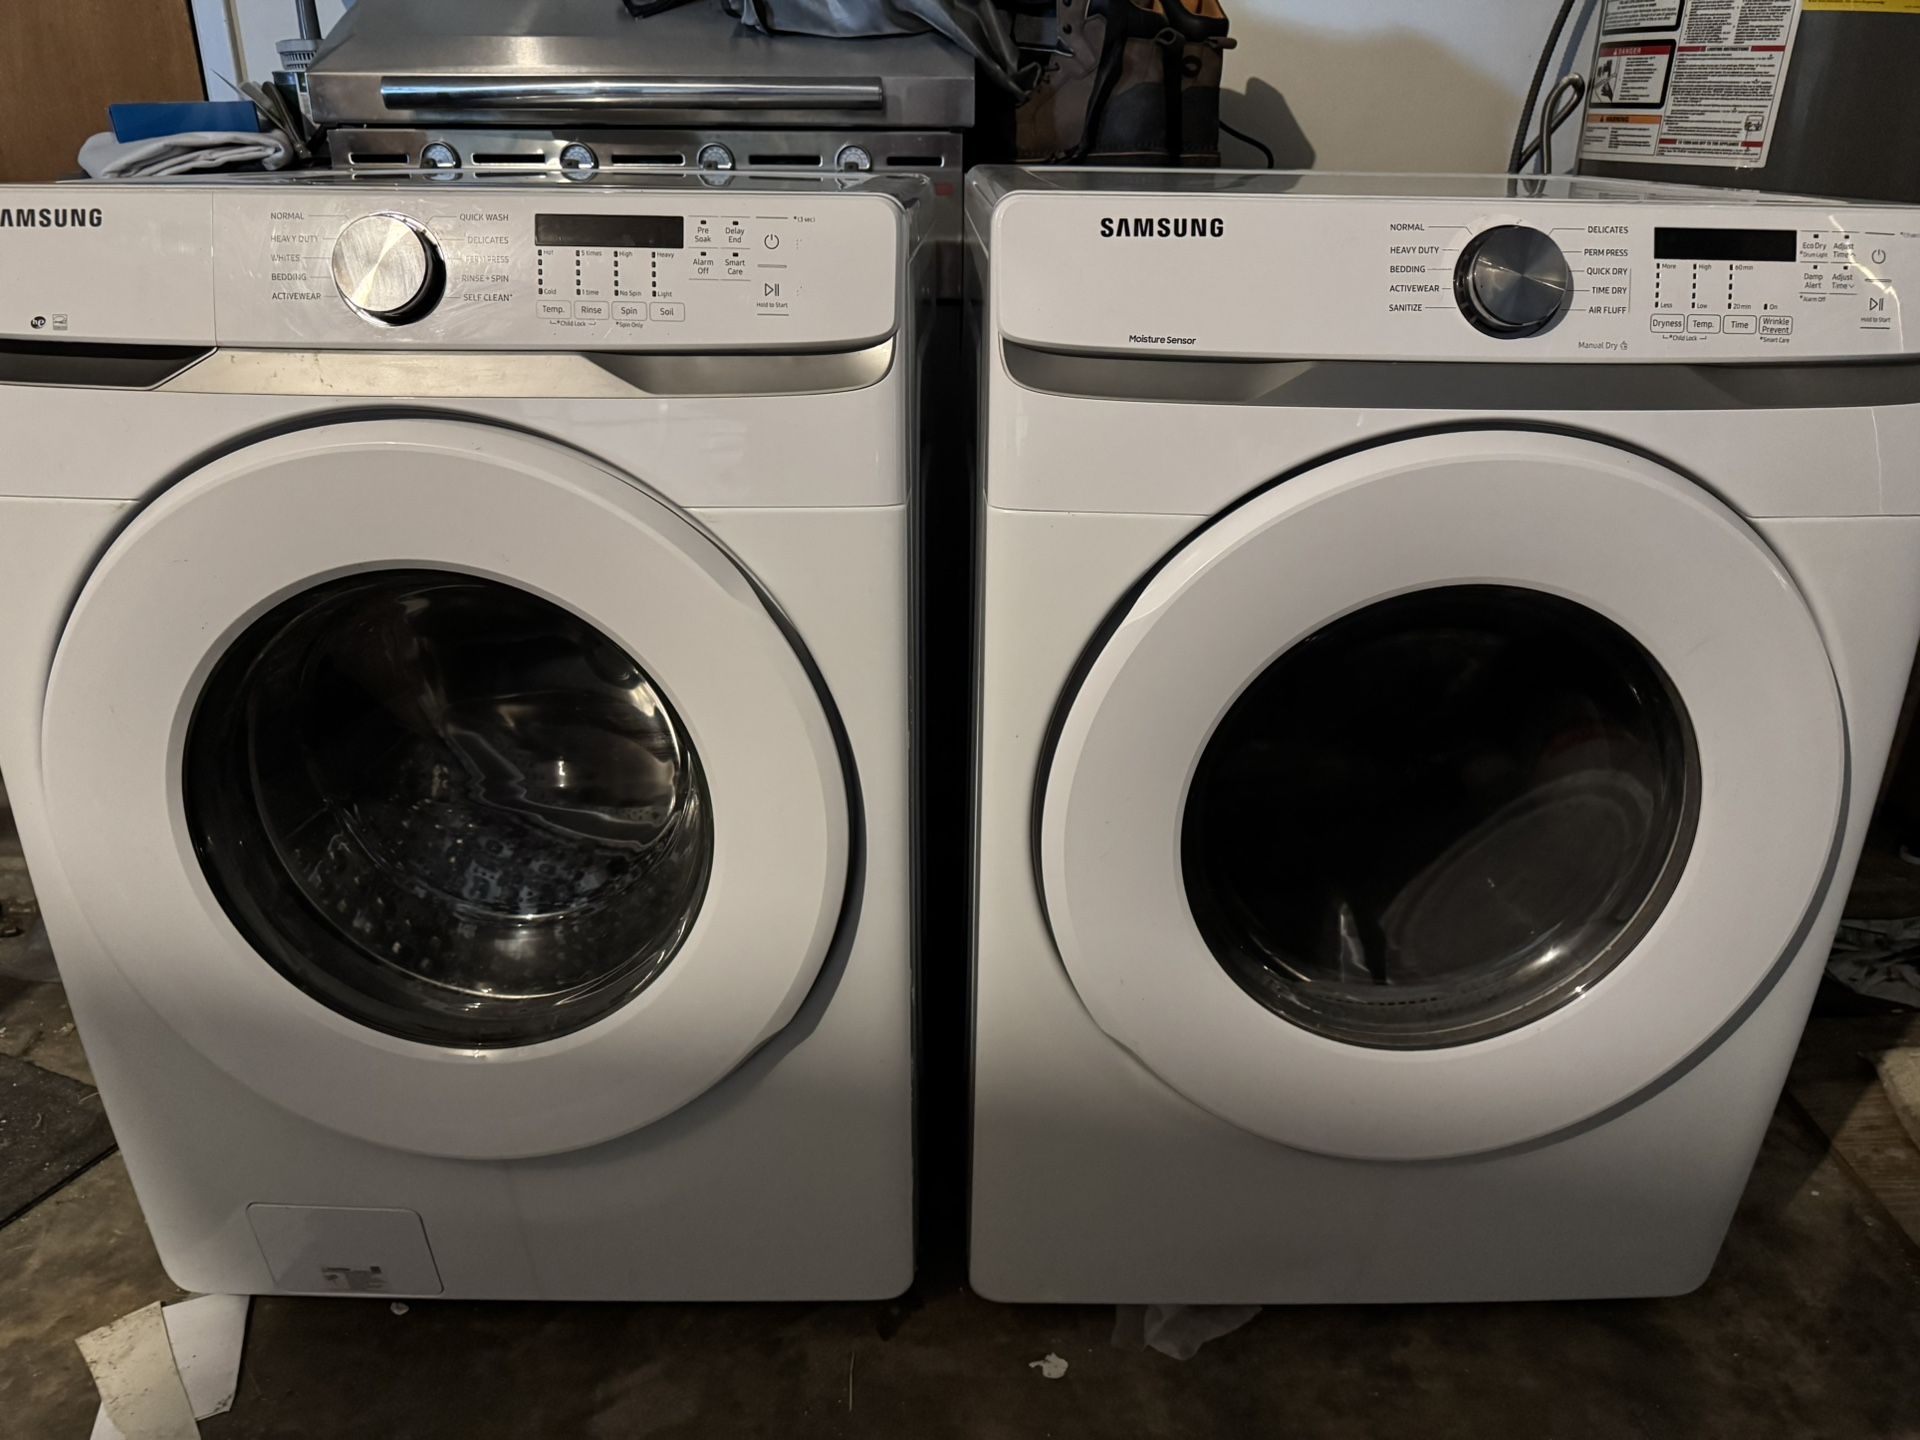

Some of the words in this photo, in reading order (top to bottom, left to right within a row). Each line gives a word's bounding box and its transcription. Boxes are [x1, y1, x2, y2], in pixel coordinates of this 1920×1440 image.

[270, 212, 304, 220] NORMAL
[459, 213, 484, 222] QUICK
[485, 213, 509, 221] WASH
[697, 226, 709, 234] Pre
[1100, 217, 1224, 238] SAMSUNG
[1390, 223, 1425, 231] NORMAL
[1587, 226, 1629, 234] DELICATES
[725, 227, 745, 236] Delay
[270, 235, 296, 243] HEAVY
[299, 235, 318, 243] DUTY
[467, 236, 509, 244] DELICATES
[694, 235, 712, 243] Soak
[728, 236, 742, 244] End
[1390, 246, 1417, 254] HEAVY
[1418, 246, 1440, 254] DUTY
[1833, 242, 1854, 251] Adjust
[1584, 248, 1605, 257] PERM
[1605, 249, 1629, 257] PRESS
[271, 254, 300, 262] WHITES
[693, 258, 714, 266] Alarm
[725, 259, 746, 267] Smart
[697, 267, 709, 275] Off
[1390, 265, 1426, 273] BEDDING
[1586, 267, 1611, 276] QUICK
[1611, 267, 1628, 275] DRY
[1698, 263, 1712, 272] High
[727, 268, 743, 276] Care
[271, 273, 307, 281] BEDDING
[1803, 273, 1823, 281] Damp
[1832, 273, 1853, 282] Adjust
[1389, 284, 1440, 292] ACTIVEWEAR
[1804, 281, 1822, 289] Alert
[1832, 282, 1848, 290] Time
[1592, 286, 1610, 294] TIME
[1611, 286, 1627, 295] DRY
[272, 292, 321, 300] ACTIVEWEAR
[463, 294, 482, 302] SELF
[542, 305, 565, 314] Temp.
[581, 306, 602, 314] Rinse
[621, 307, 638, 316] Spin
[659, 308, 674, 316] Soil
[1389, 304, 1423, 312] SANITIZE
[1588, 306, 1602, 314] AIR
[1602, 306, 1627, 315] FLUFF
[1652, 319, 1682, 331] Dryness
[1693, 320, 1715, 331] Temp.
[1731, 320, 1749, 329] Time
[1762, 317, 1790, 326] Wrinkle
[1762, 325, 1789, 334] Prevent
[1129, 335, 1166, 344] Moisture
[1166, 336, 1197, 345] Sensor
[1578, 341, 1604, 349] Manual
[1605, 341, 1618, 351] Dry
